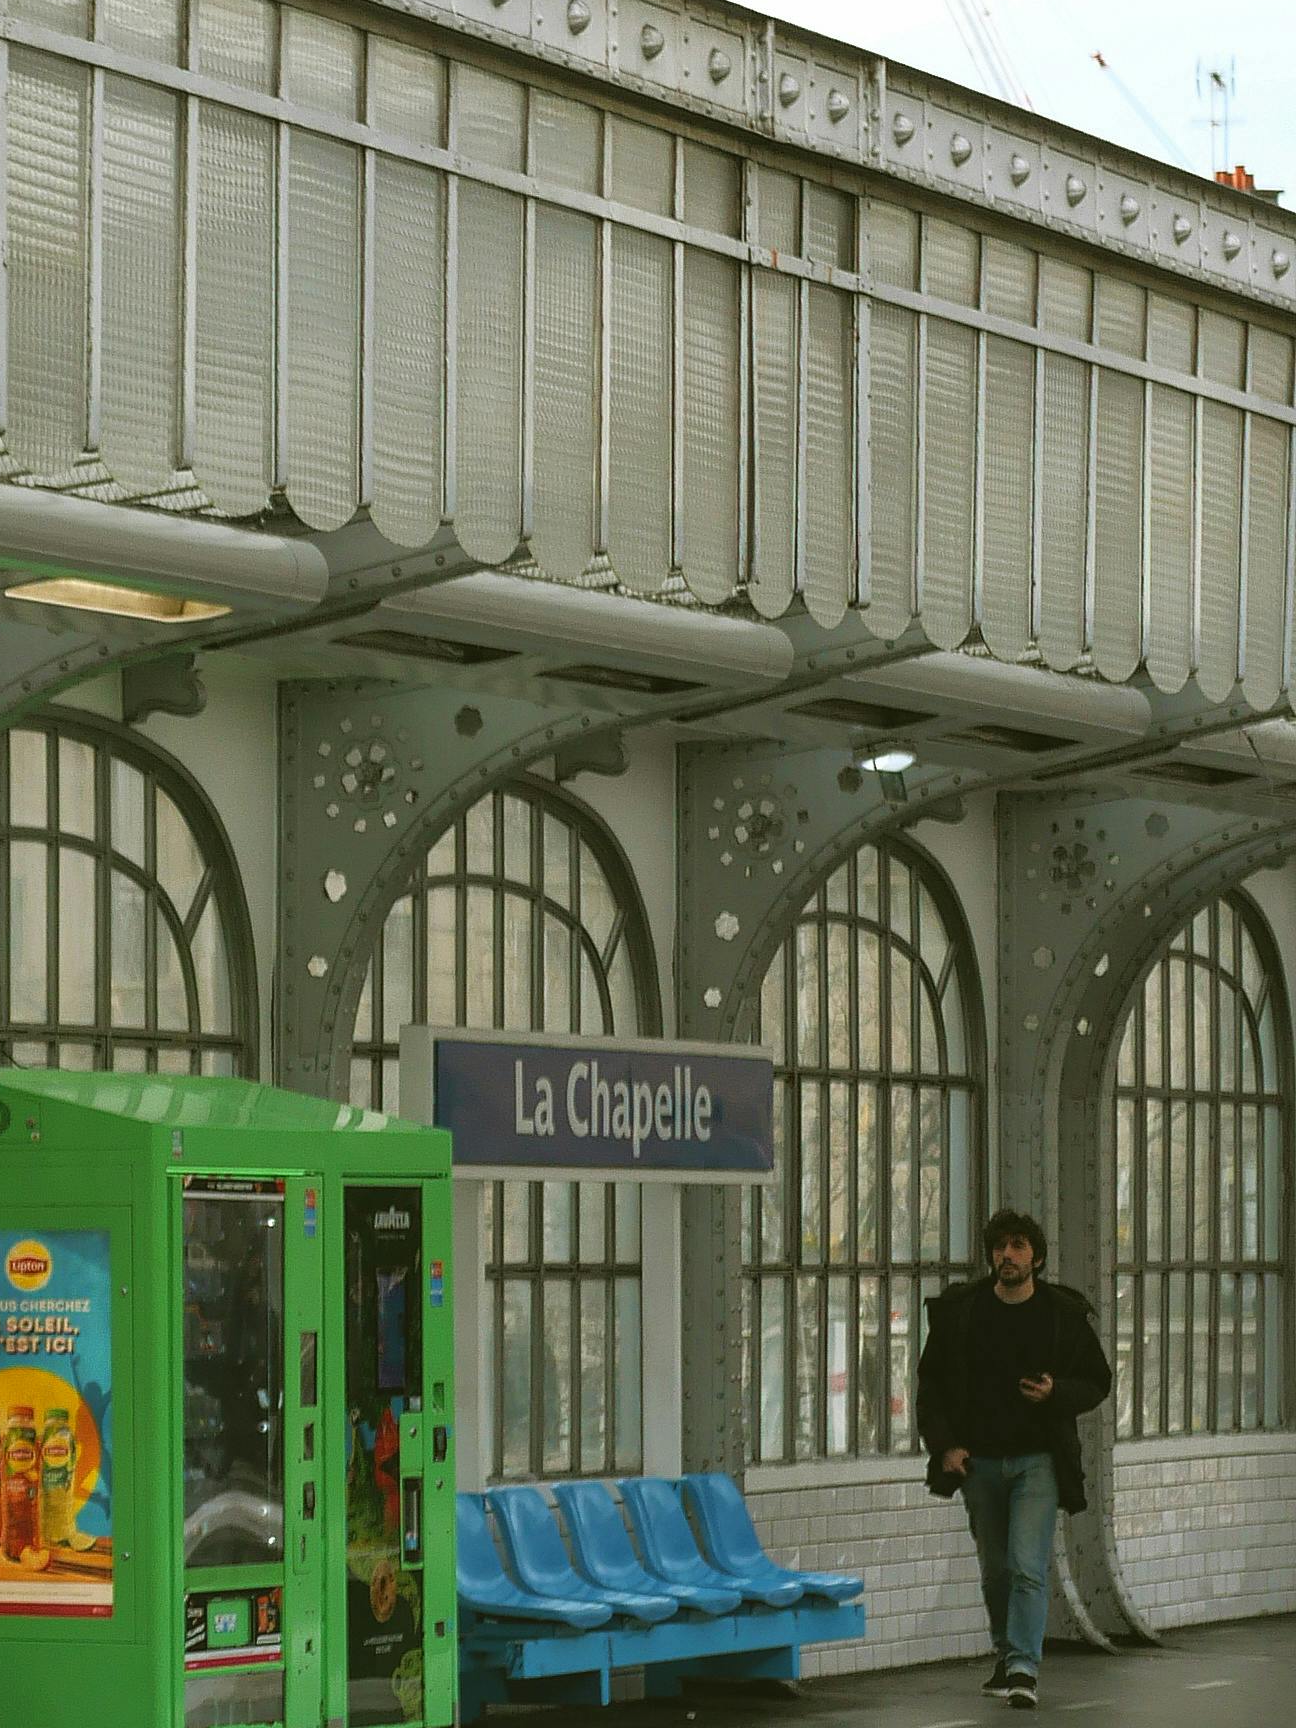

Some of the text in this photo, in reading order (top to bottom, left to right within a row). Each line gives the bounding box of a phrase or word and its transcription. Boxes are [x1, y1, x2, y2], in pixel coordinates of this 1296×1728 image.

[514, 1059, 712, 1159] La Chapelle
[11, 1259, 46, 1274] Lipton
[19, 1299, 91, 1313] CHERCHEZ
[6, 1316, 80, 1336] SOLEIL,
[45, 1336, 75, 1354] ICI
